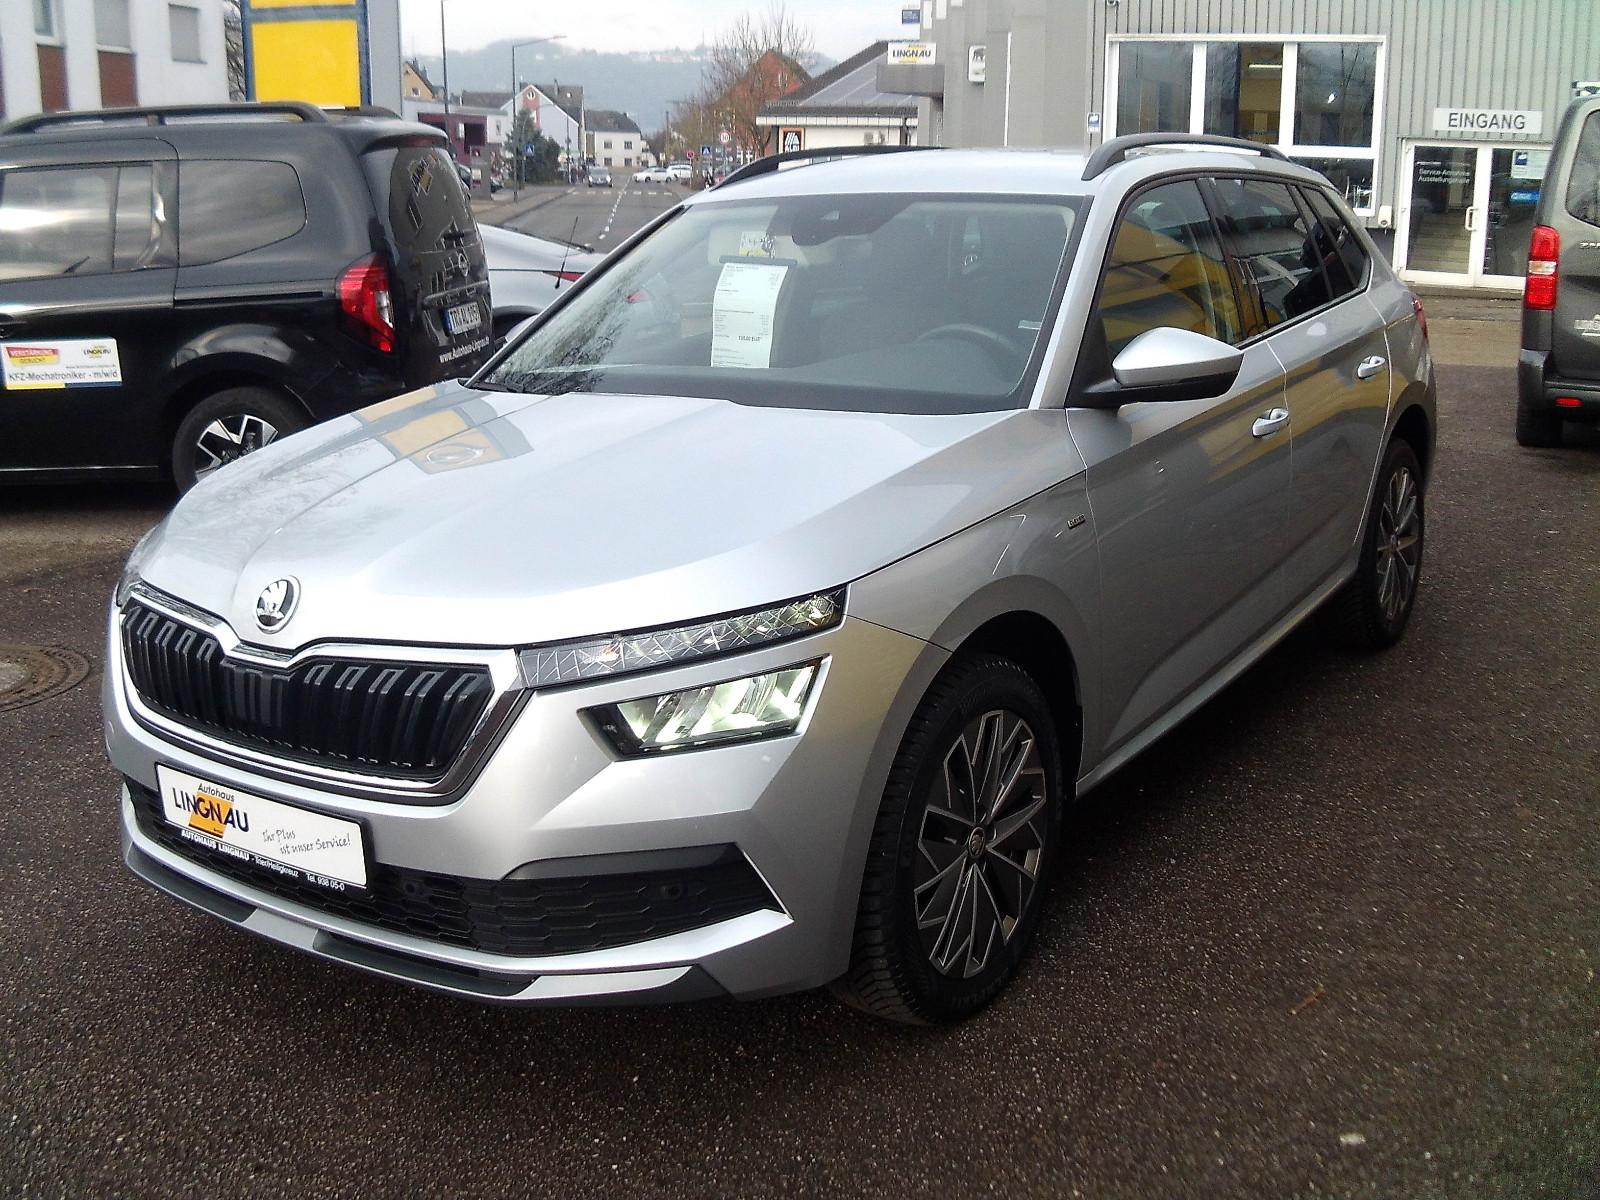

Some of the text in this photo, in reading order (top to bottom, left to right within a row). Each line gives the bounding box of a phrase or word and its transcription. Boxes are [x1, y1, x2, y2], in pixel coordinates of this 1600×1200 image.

[892, 49, 931, 57] LINGNAU
[1448, 112, 1526, 130] EINGANG
[9, 371, 86, 381] KFZ-Mechatroniker
[198, 783, 234, 802] Autohaus
[172, 787, 249, 832] LINGNAU
[263, 828, 296, 844] Ihr Plus
[279, 832, 351, 855] ist unser Service!
[181, 829, 217, 850] AUTOHAUS
[218, 841, 250, 861] LINGNAU
[306, 872, 316, 883] Tel.
[317, 876, 330, 887] 938
[330, 880, 345, 891] 05-0
